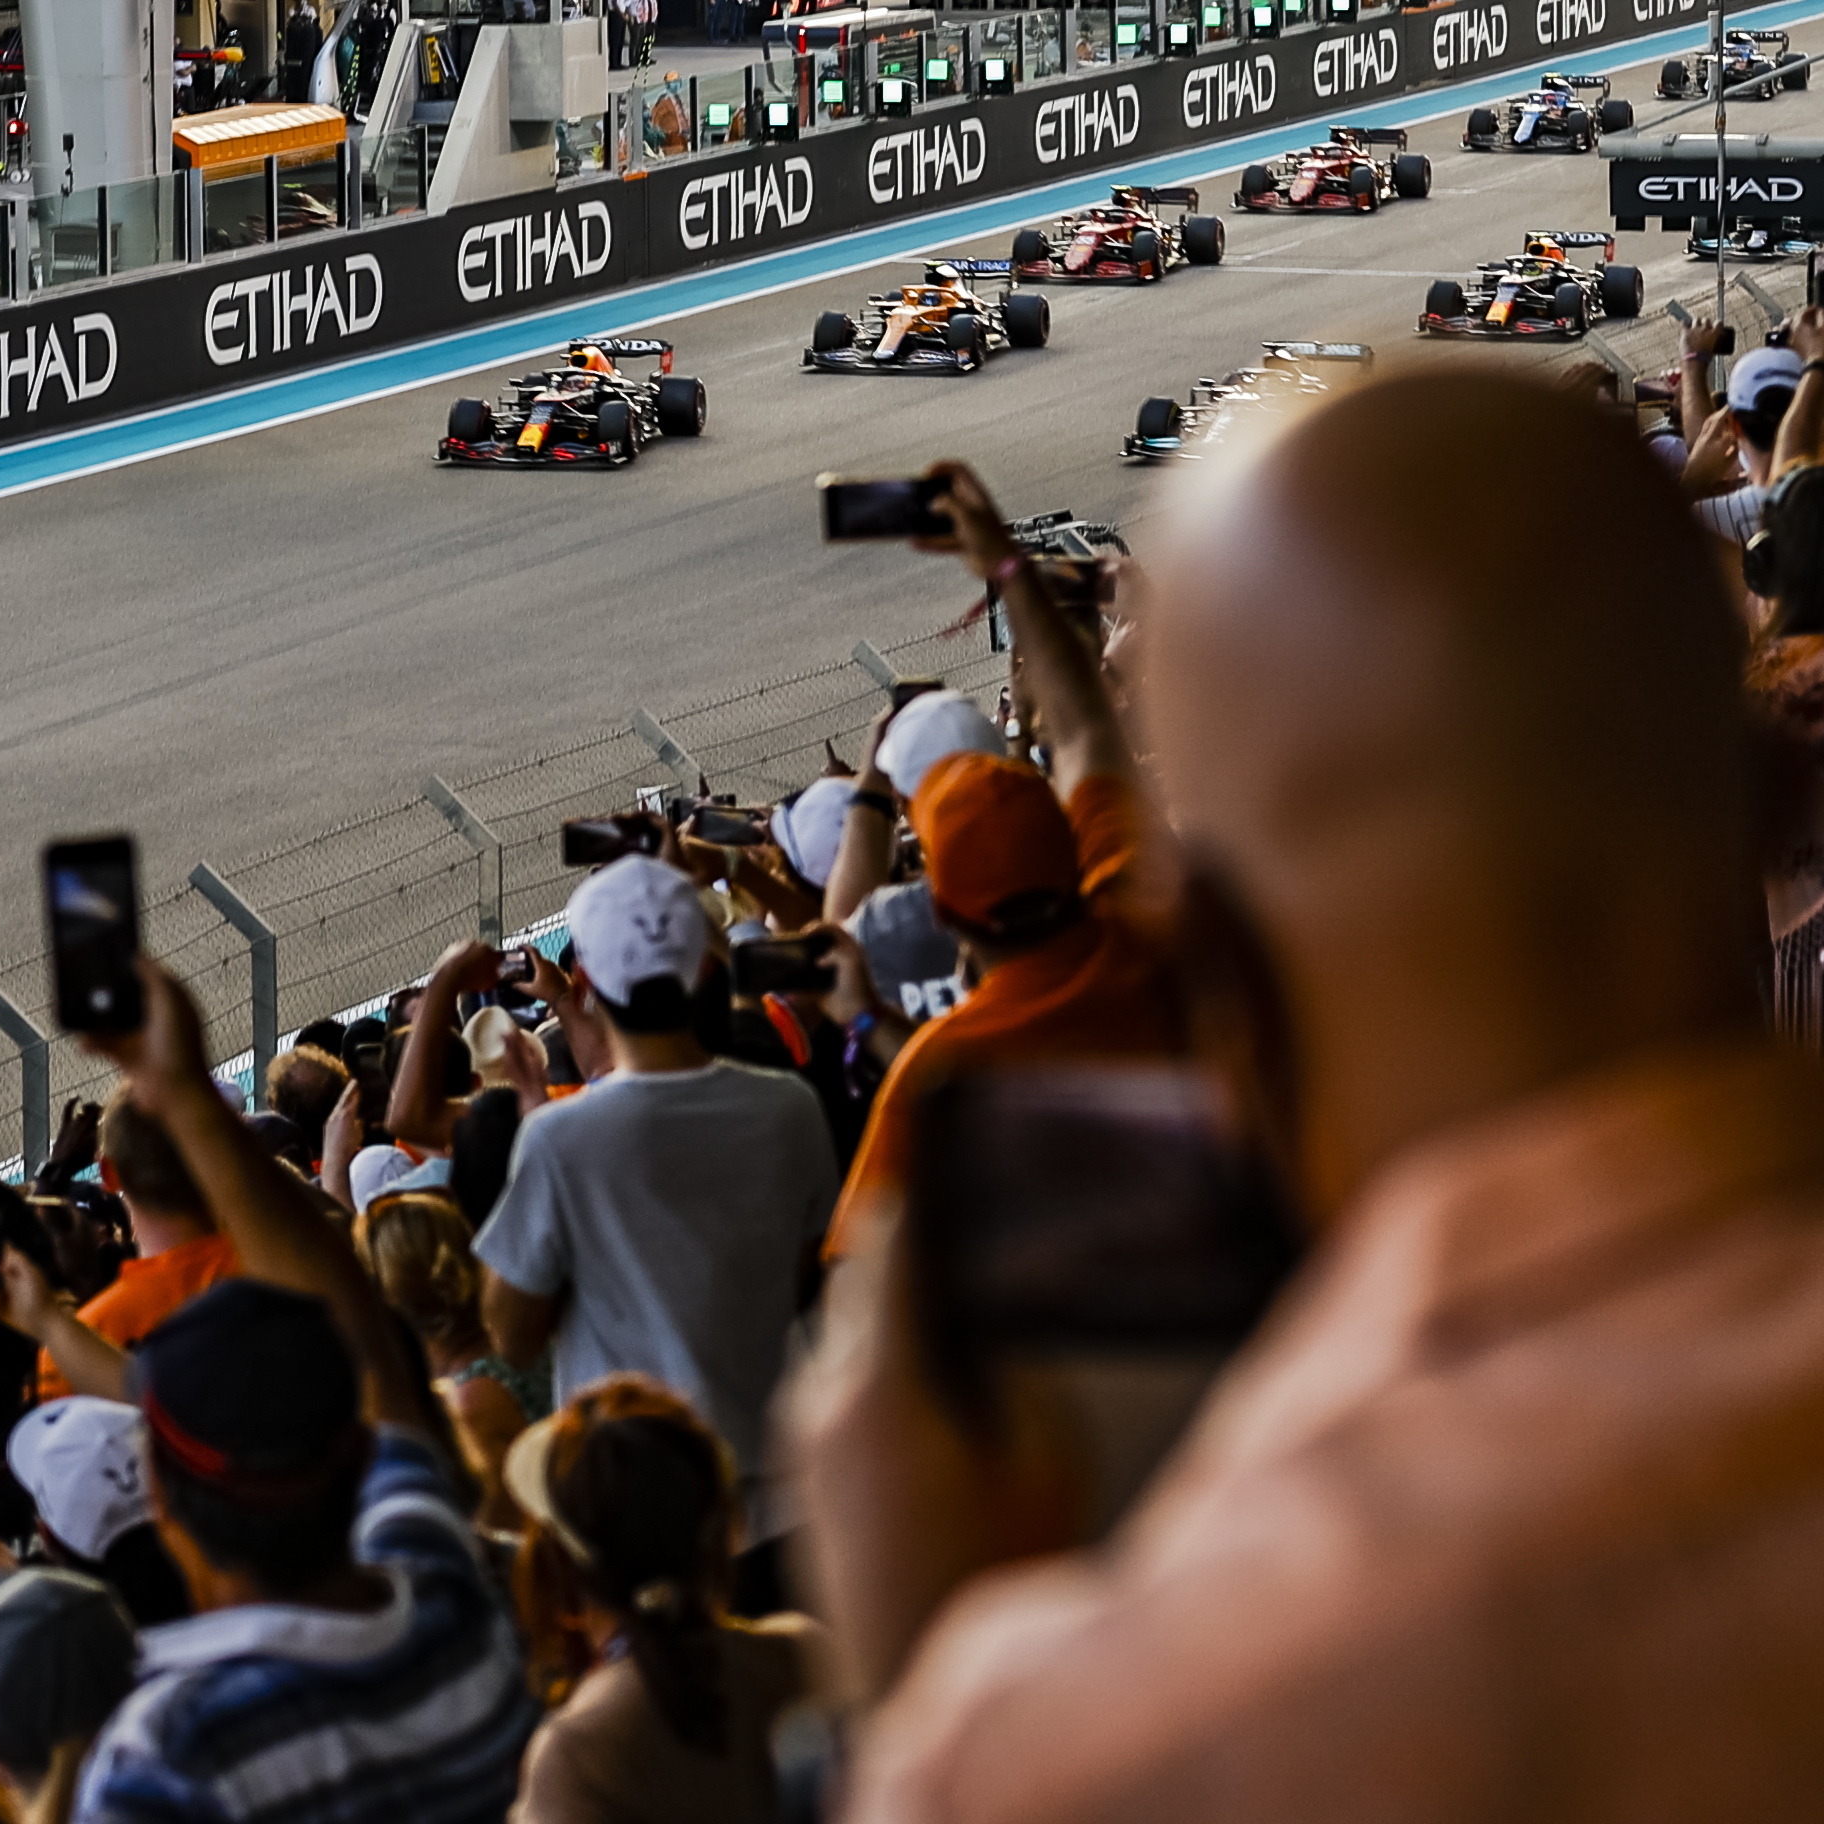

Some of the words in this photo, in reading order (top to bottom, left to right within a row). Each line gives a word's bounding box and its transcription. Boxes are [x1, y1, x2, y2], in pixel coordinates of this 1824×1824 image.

[1312, 27, 1399, 98] ETIHAD
[1433, 3, 1508, 71] ETIHAD
[1035, 83, 1141, 165] ETIHAD
[1183, 54, 1277, 129] ETIHAD
[868, 117, 986, 205] ETIHAD
[1638, 175, 1804, 203] ETIHAD
[679, 156, 814, 252] ETIHAD
[457, 200, 612, 304] ETIHAD
[204, 253, 384, 367] ETIHAD
